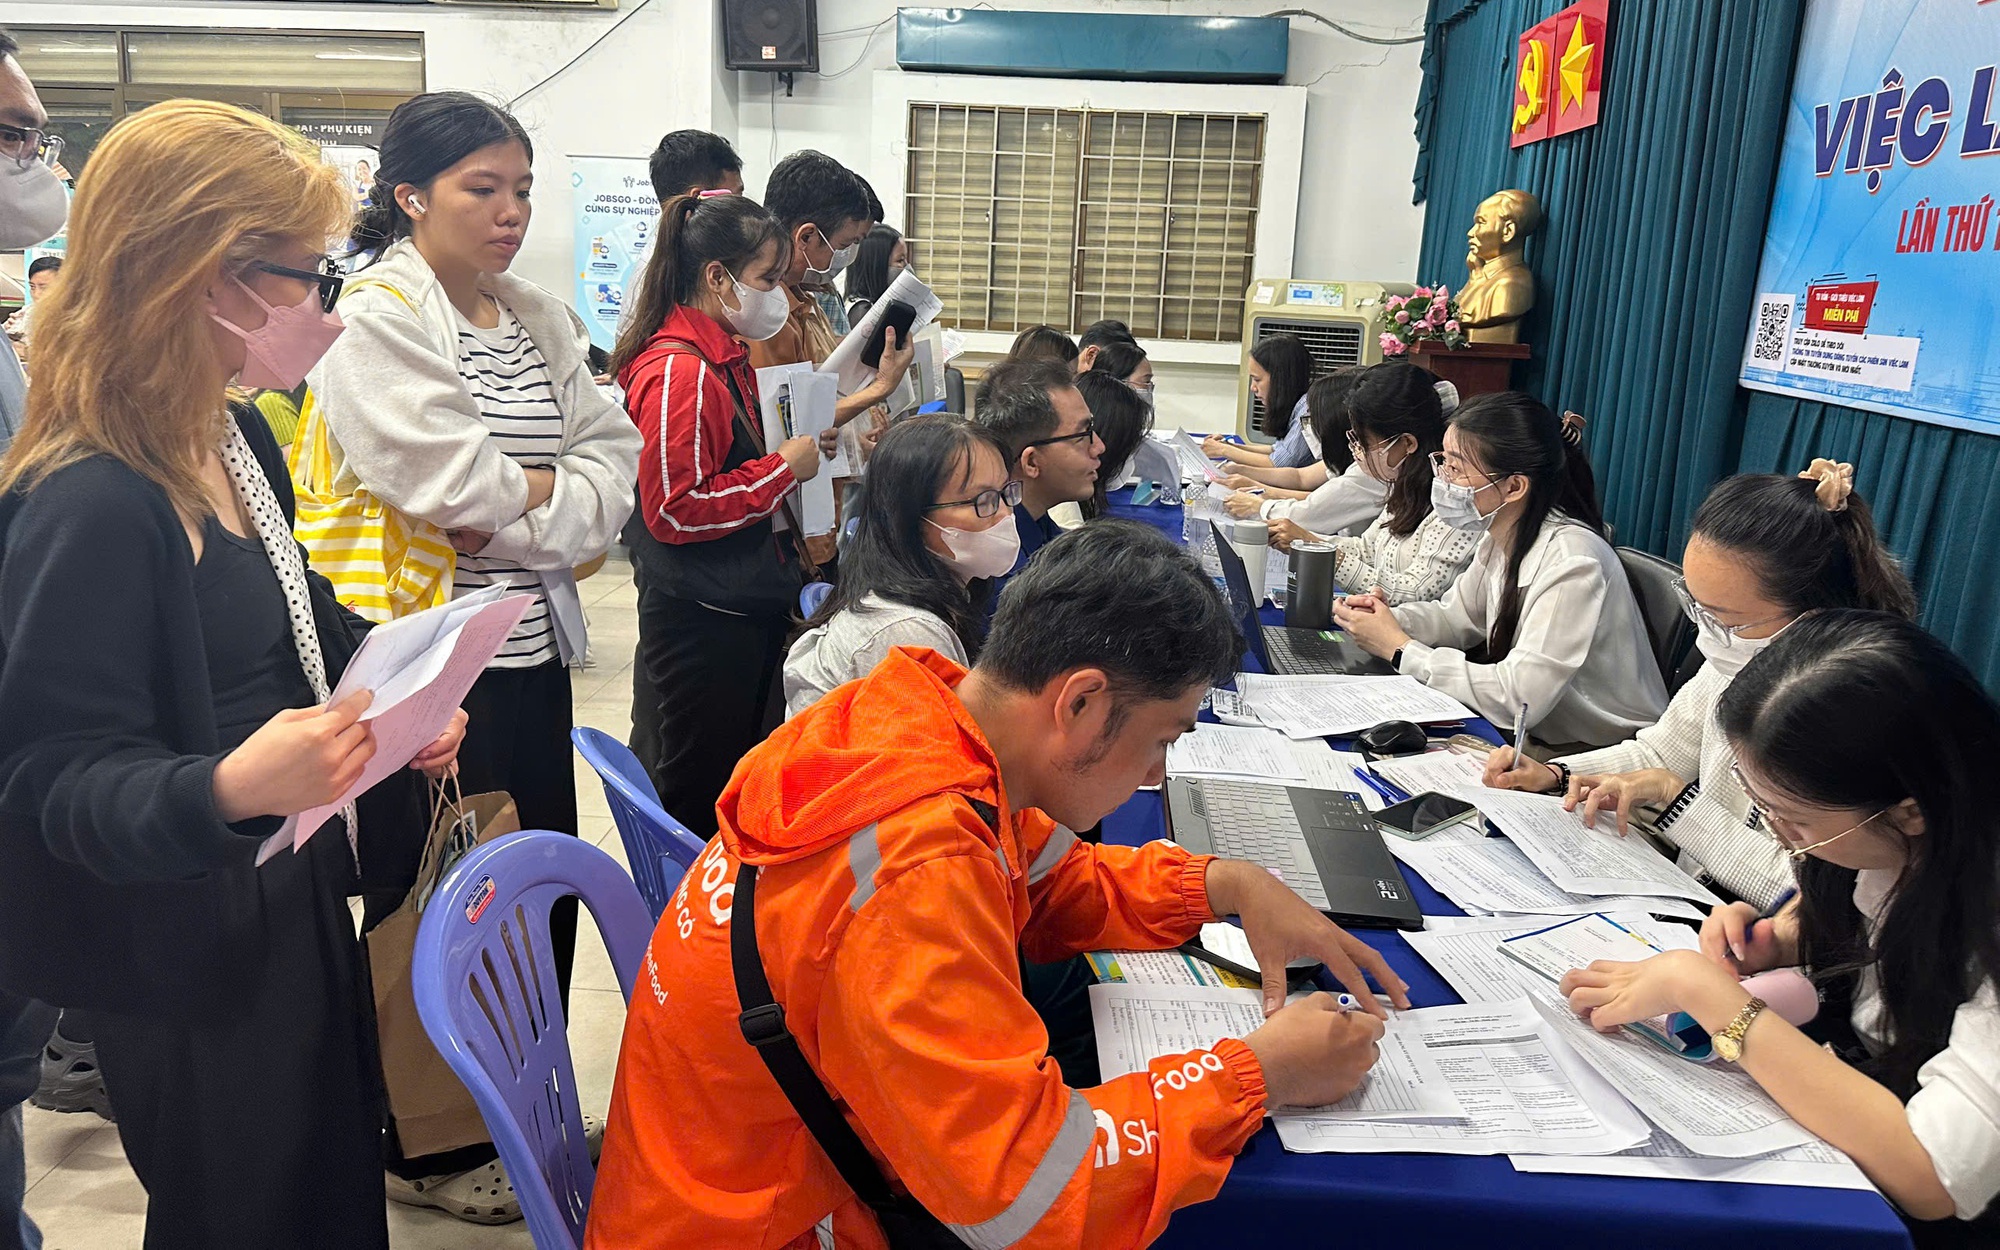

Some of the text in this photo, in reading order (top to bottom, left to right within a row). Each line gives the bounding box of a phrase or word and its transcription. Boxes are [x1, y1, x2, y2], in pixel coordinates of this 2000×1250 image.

[320, 124, 343, 135] PHỤ
[1815, 65, 2000, 193] VIỆC L
[594, 194, 631, 203] JOBSGO
[585, 202, 660, 217] CÙNG SỰ NGHIỆP
[1895, 197, 1941, 253] LẦN
[1943, 193, 1995, 252] THỨ
[1823, 304, 1860, 322] MIỄN PHÍ
[677, 907, 695, 939] CÓ
